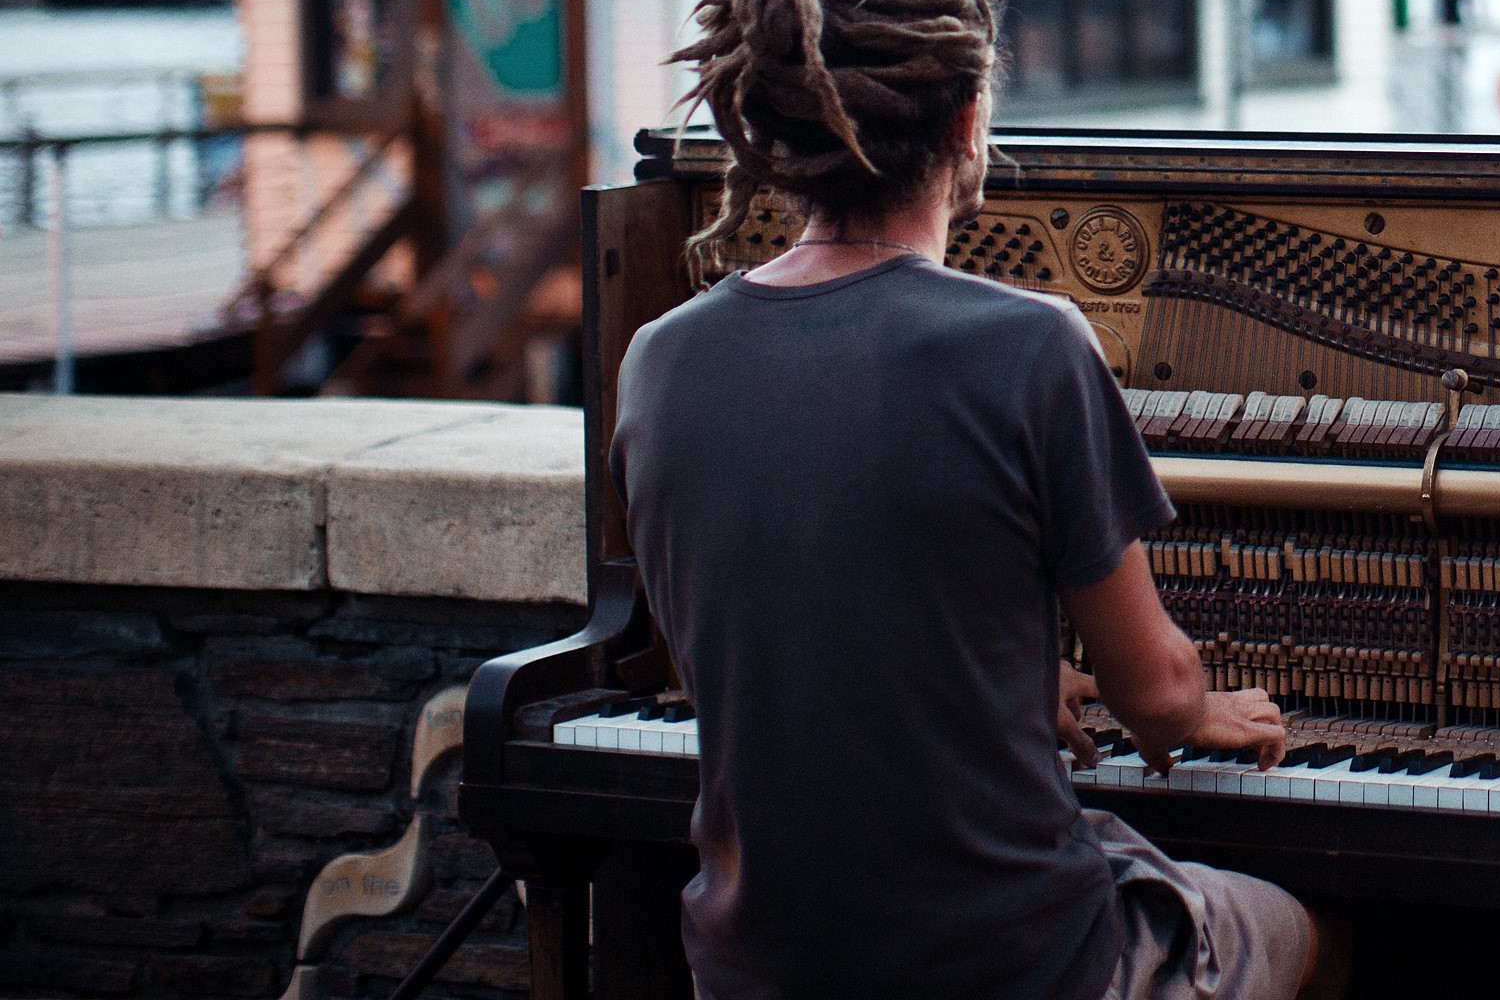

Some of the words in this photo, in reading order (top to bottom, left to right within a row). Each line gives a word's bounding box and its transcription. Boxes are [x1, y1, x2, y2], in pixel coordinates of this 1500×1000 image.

[1077, 215, 1137, 252] COLLARD
[1098, 241, 1115, 262] &
[1079, 256, 1136, 285] COLLARD
